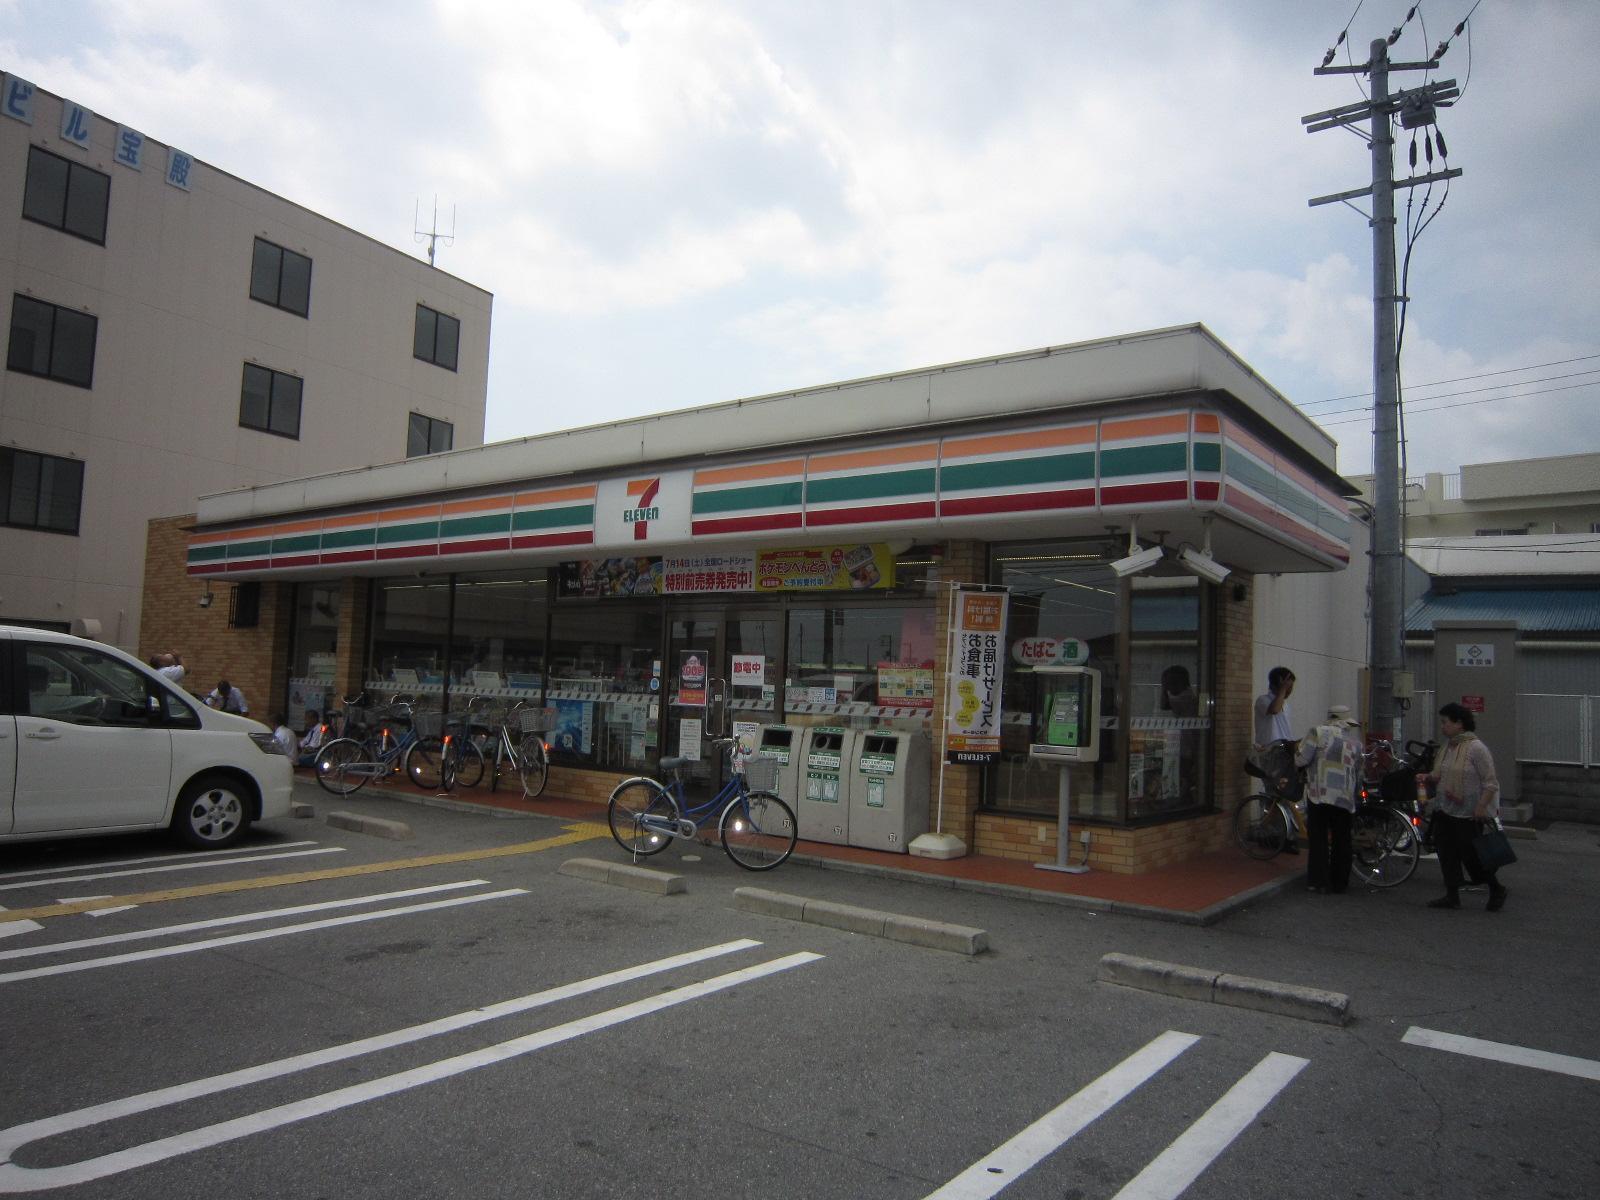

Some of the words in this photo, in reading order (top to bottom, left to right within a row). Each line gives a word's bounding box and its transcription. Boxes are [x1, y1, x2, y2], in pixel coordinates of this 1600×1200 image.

[627, 477, 660, 540] 7
[1021, 641, 1057, 658] たばこ
[1063, 641, 1079, 659] 酒
[734, 662, 761, 674] 節電中
